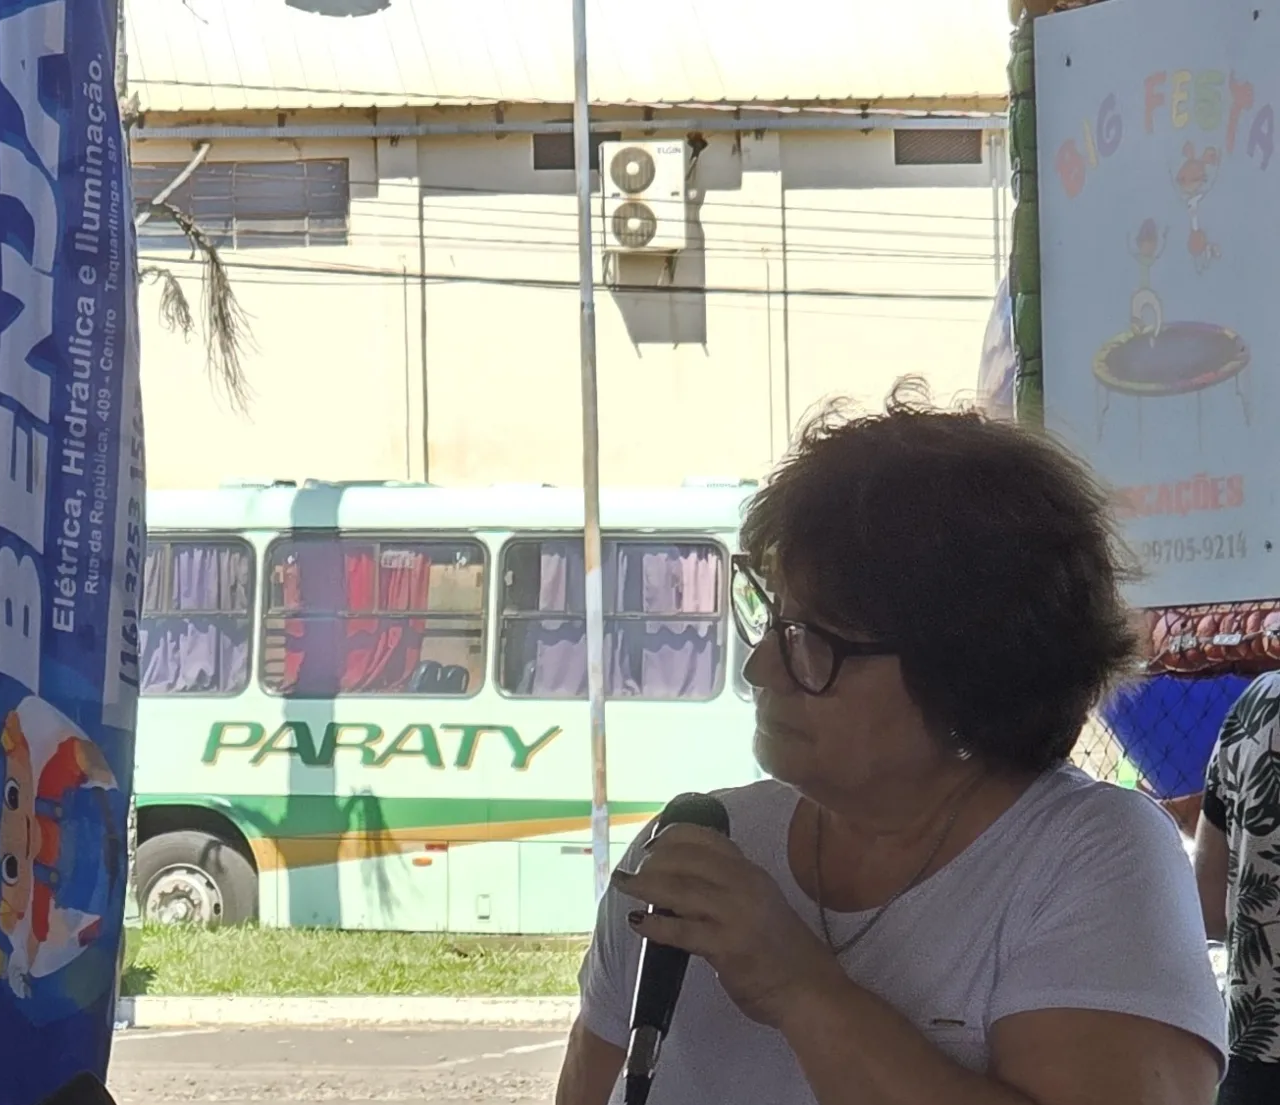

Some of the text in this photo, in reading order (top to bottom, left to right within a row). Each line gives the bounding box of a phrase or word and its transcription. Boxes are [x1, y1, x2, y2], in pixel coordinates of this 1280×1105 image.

[108, 137, 118, 161] SP
[1055, 68, 1275, 198] BIG FESTA
[105, 183, 120, 291] Taquaritinga
[53, 53, 107, 633] Elétrica, Hidráulica e Iluminação.
[100, 309, 116, 371] Centro
[96, 388, 111, 422] 409
[89, 427, 110, 524] República,
[88, 529, 102, 554] da
[85, 557, 101, 594] Rua
[201, 721, 563, 771] PARATY
